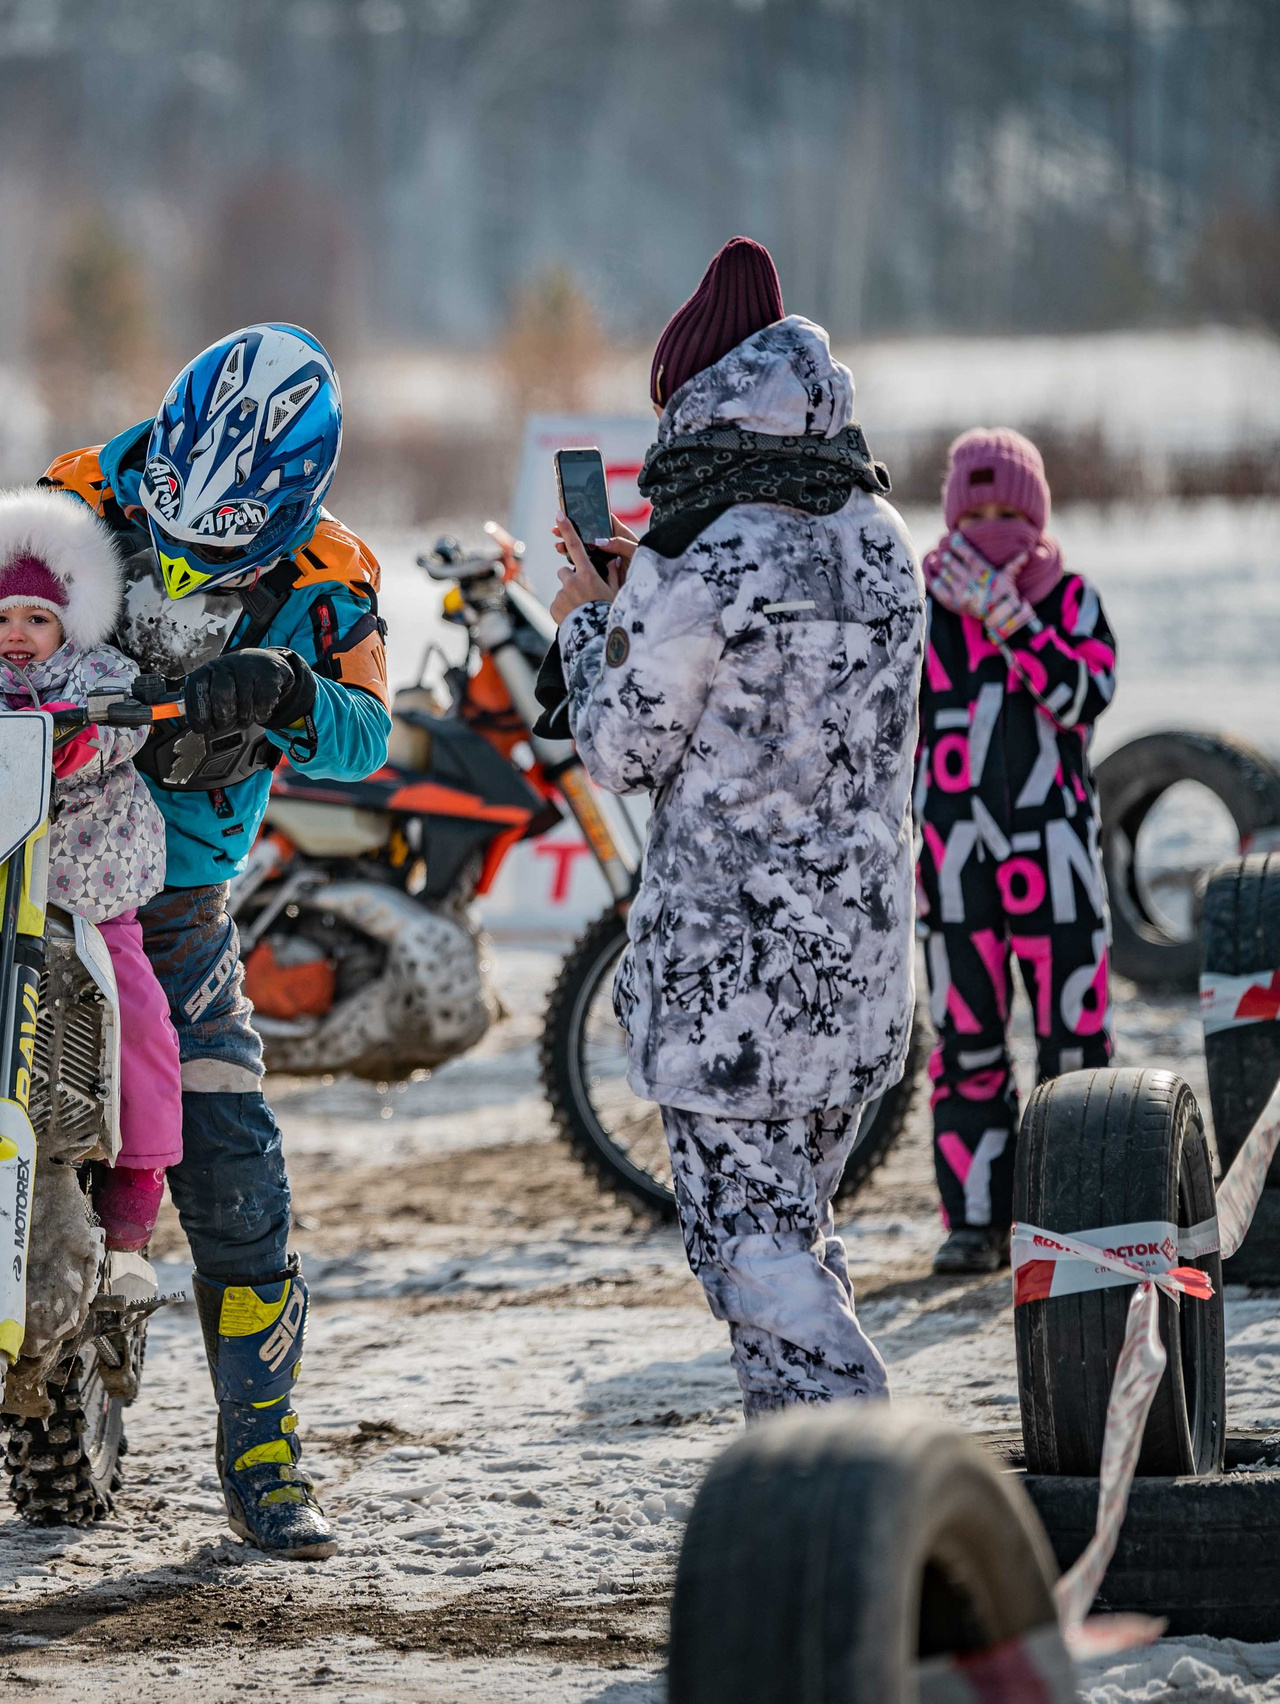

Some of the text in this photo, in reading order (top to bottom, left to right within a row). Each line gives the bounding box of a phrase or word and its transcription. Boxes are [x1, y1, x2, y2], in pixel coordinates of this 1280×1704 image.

[148, 462, 180, 519] Airoh
[197, 503, 264, 534] Airoh
[14, 1156, 30, 1250] MOTOREX
